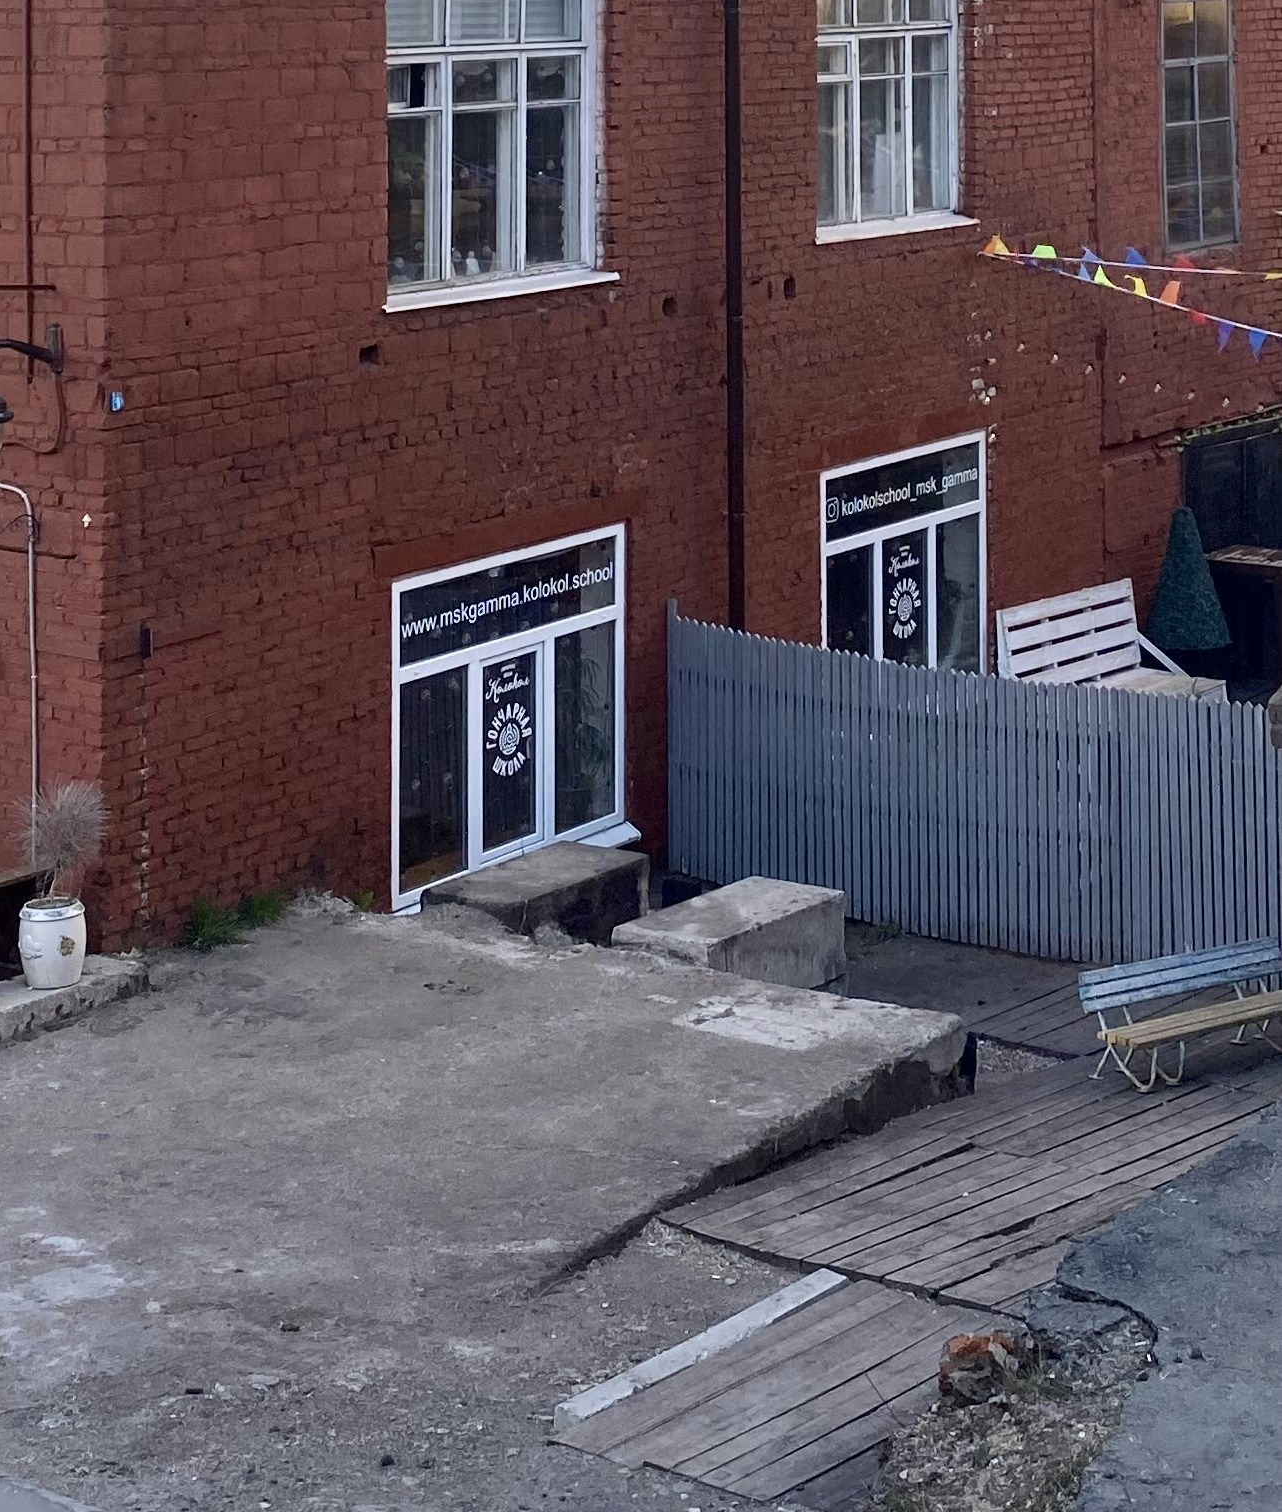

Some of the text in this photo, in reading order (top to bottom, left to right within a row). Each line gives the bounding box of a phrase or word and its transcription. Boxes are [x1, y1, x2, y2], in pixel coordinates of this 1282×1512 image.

[841, 467, 978, 517] kolokolschool_msk_gamma
[401, 561, 614, 639] www.mskgamma.kolokol.school
[485, 672, 530, 704] Колокол
[486, 702, 533, 749] ГОНЧАРНАЯ
[491, 751, 526, 777] ШКОЛА
